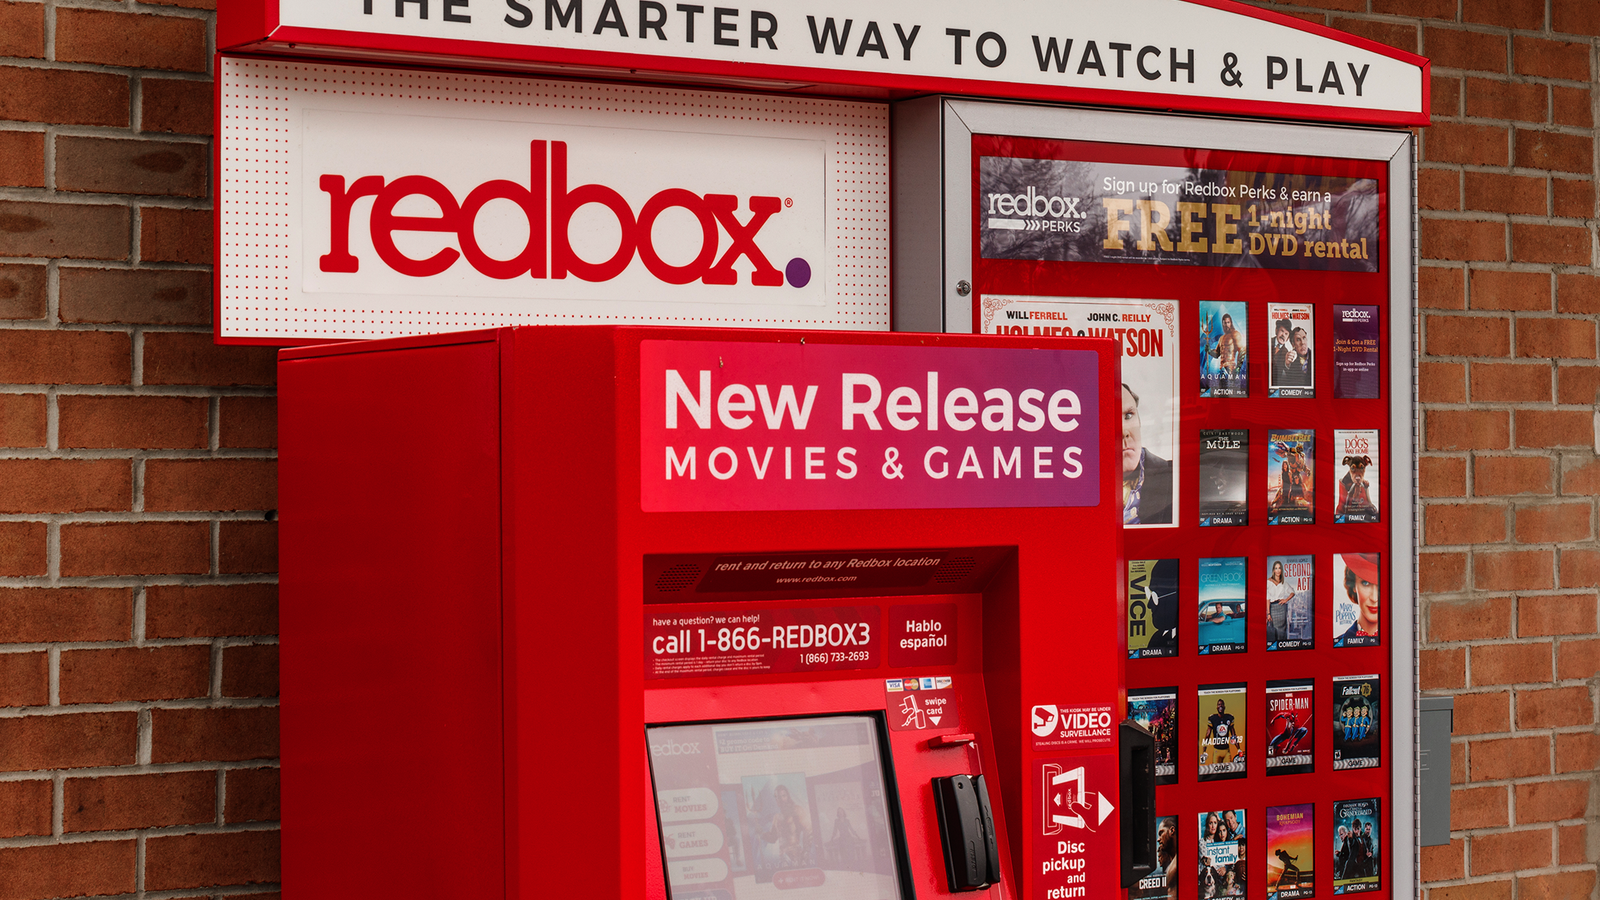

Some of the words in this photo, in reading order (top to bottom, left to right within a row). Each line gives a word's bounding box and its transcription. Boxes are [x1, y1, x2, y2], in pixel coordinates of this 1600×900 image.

[503, 0, 779, 51] SMARTER
[807, 15, 922, 62] WAY
[945, 28, 1008, 68] TO
[1031, 35, 1195, 84] WATCH
[1220, 52, 1244, 88] &
[1267, 56, 1371, 97] PLAY
[1103, 176, 1135, 195] Sign
[1139, 182, 1158, 196] up
[1162, 179, 1182, 194] for
[1185, 181, 1236, 198] Redbox
[1239, 184, 1277, 200] Perks
[1280, 186, 1289, 200] &
[1292, 190, 1321, 202] earn
[1324, 191, 1332, 202] a
[1102, 197, 1243, 254] FREE
[1247, 204, 1332, 235] 1-night
[1042, 220, 1081, 233] PERKS
[1248, 232, 1298, 256] DVD
[1303, 237, 1369, 260] rental
[1006, 310, 1029, 320] WILL
[1029, 311, 1068, 321] FERRELL
[1087, 313, 1111, 322] JOHN
[1112, 313, 1121, 322] C.
[1122, 313, 1151, 323] REILLY
[1213, 388, 1234, 396] ACTION
[664, 369, 819, 430] New
[841, 371, 1082, 432] Release
[1206, 440, 1241, 449] MULE
[1344, 437, 1369, 449] DOG'S
[664, 445, 858, 480] MOVIES
[881, 446, 905, 480] &
[923, 445, 1084, 480] GAMES
[714, 562, 741, 572] rent
[743, 560, 767, 571] and
[768, 560, 808, 570] return
[808, 559, 822, 569] to
[823, 559, 846, 571] any
[847, 557, 892, 568] Redbox
[892, 556, 941, 567] location
[1284, 563, 1311, 577] SECOND
[776, 574, 857, 584] www.redbox.com
[1223, 572, 1243, 582] BOOK
[1297, 577, 1311, 591] ACT
[1129, 574, 1147, 637] VICE
[652, 617, 672, 626] have
[678, 615, 714, 627] question?
[742, 614, 760, 625] help!
[905, 620, 942, 633] Hablo
[652, 629, 691, 655] call
[698, 622, 871, 653] 1-866-REDBOX3
[899, 634, 947, 652] español
[1278, 640, 1301, 648] COMEDY
[1347, 637, 1364, 645] FAMILY
[1212, 644, 1232, 652] DRAMA
[800, 654, 803, 664] 1
[805, 652, 829, 665] (866)
[830, 651, 870, 663] 733-2693
[925, 697, 947, 706] swipe
[1269, 697, 1309, 711] SPIDER-MAN
[926, 706, 943, 715] card
[1060, 712, 1112, 729] VIDEO
[1060, 728, 1111, 738] SURVEILLANCE
[726, 738, 748, 747] promo
[1201, 737, 1230, 746] MADDEN
[1236, 735, 1244, 744] 19
[674, 804, 708, 813] MOVIES
[1276, 812, 1304, 821] BOHEMIAN
[677, 831, 696, 839] RENT
[678, 839, 709, 849] GAMES
[1057, 841, 1085, 855] Disc
[1206, 846, 1230, 856] instant
[1042, 856, 1086, 875] pickup
[1214, 854, 1238, 865] family
[683, 872, 709, 880] MOVIES
[1067, 872, 1086, 884] and
[1138, 877, 1161, 890] CREED
[1161, 876, 1167, 887] II
[1346, 883, 1366, 891] ACTION
[1047, 885, 1086, 900] return
[1280, 890, 1300, 898] DRAMA
